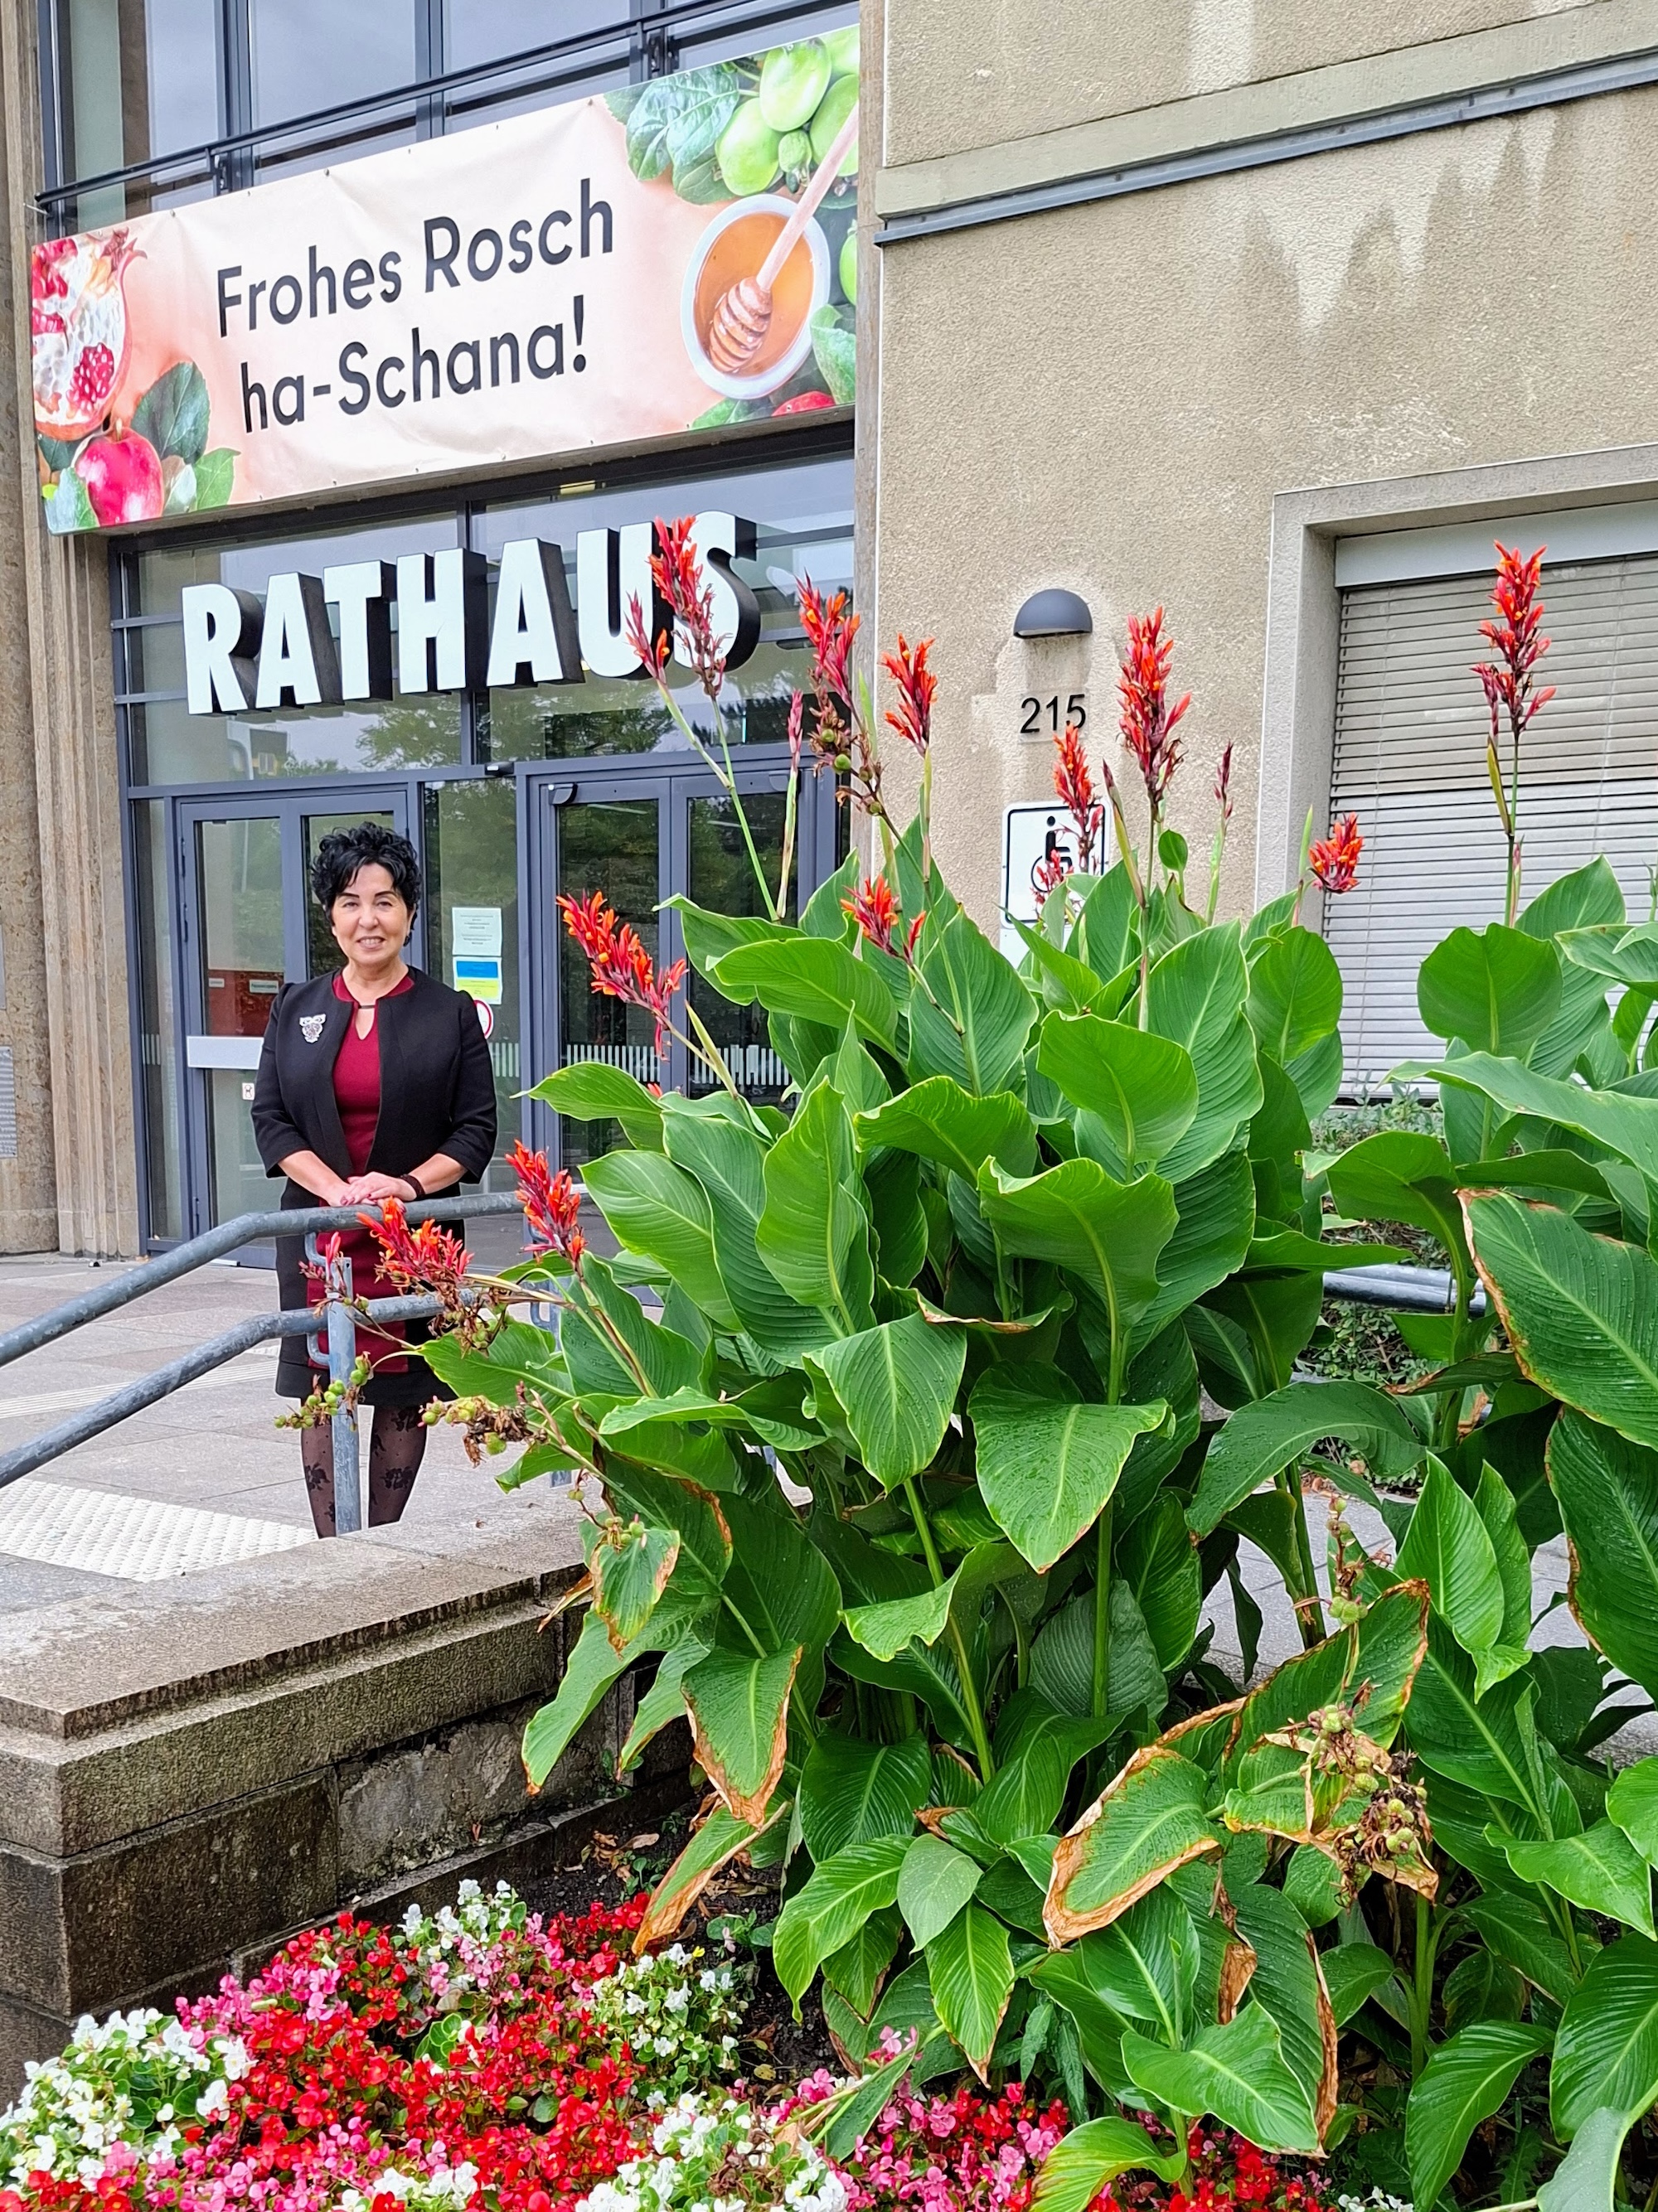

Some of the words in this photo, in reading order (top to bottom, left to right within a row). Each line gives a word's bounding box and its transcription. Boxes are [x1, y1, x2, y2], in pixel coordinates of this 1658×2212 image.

[217, 245, 402, 338] Frohes
[424, 177, 613, 293] Rosch
[240, 294, 587, 434] ha-Schana!
[182, 510, 746, 715] RATHAUS
[1020, 694, 1086, 734] 215
